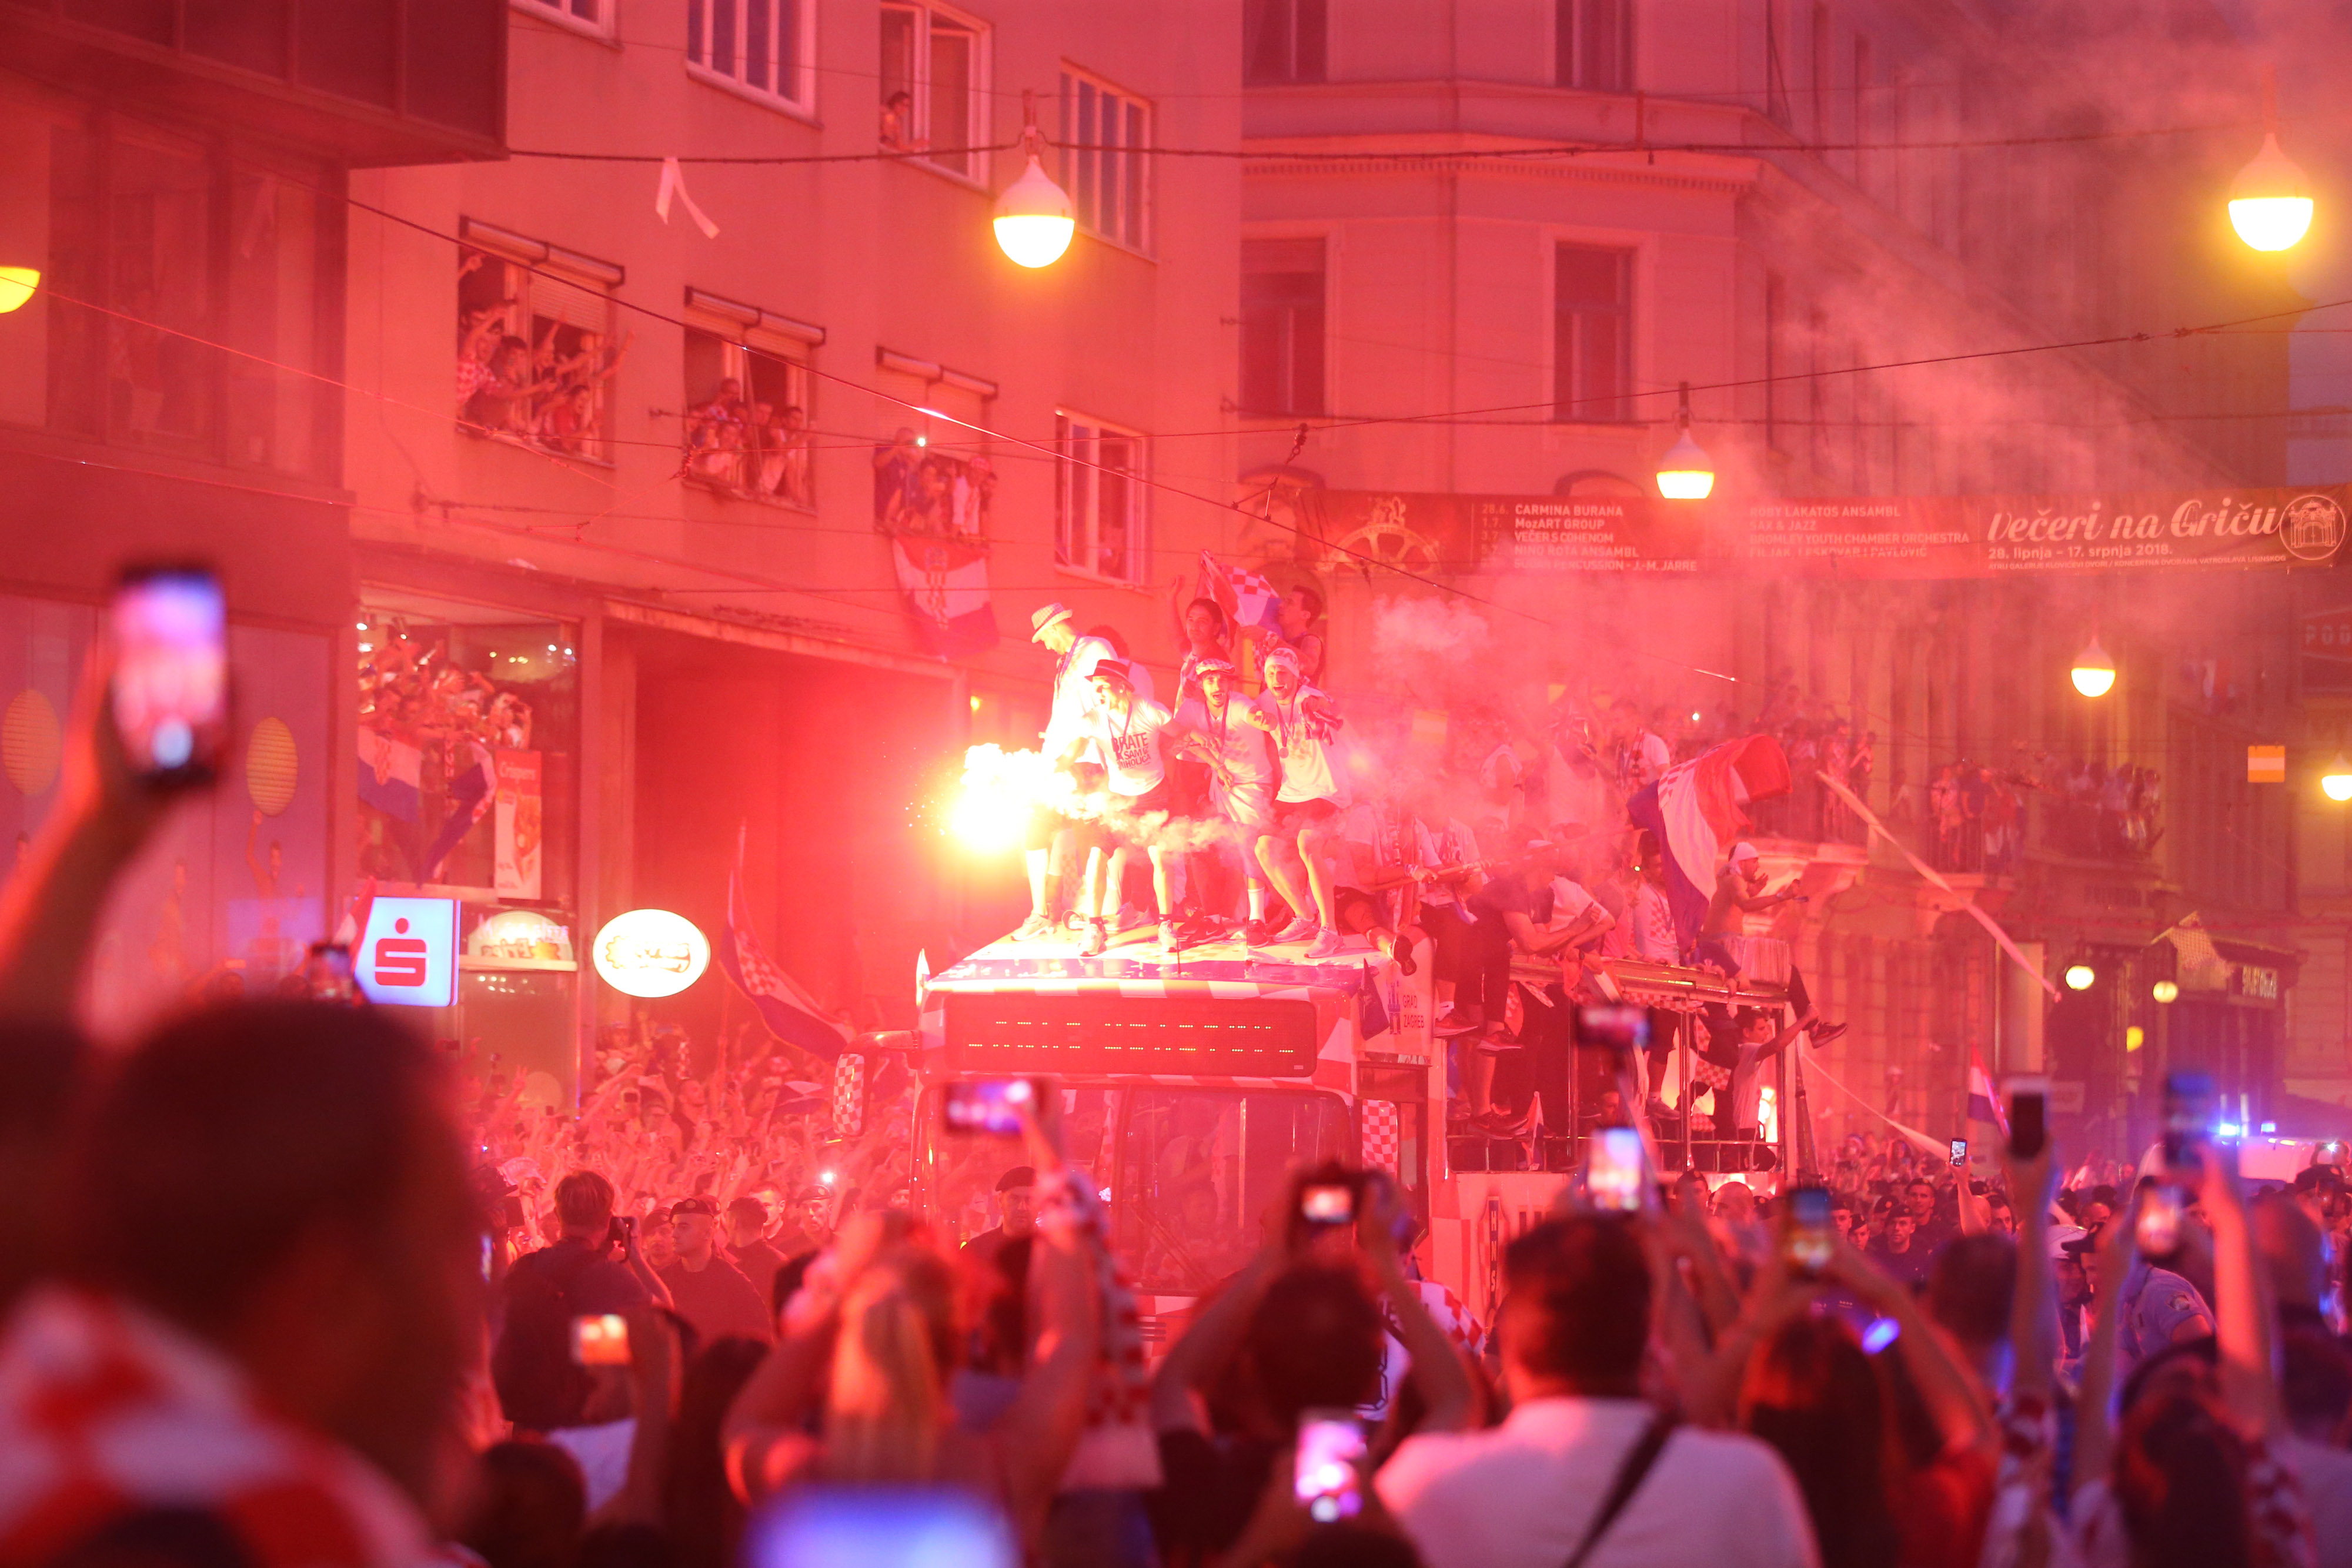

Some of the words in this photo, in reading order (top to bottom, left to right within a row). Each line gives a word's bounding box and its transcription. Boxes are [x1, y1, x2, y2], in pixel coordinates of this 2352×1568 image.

[1481, 504, 1508, 516] 28.6.
[1515, 504, 1569, 516] CARMINA
[1573, 505, 1623, 517] BURANA
[1750, 507, 1781, 517] ROBY
[1786, 506, 1839, 517] LAKATOS
[1842, 506, 1901, 517] ANSAMBL
[1482, 517, 1502, 529] 1.7.
[1515, 518, 1561, 529] MozART
[1564, 519, 1605, 530] GROUP
[1750, 520, 1771, 531] SAX
[1776, 520, 1784, 531] &
[1788, 520, 1816, 531] JAZZ
[1987, 501, 2103, 542] Večeri
[2109, 513, 2164, 540] na
[2170, 497, 2281, 538] Griču
[1515, 529, 1550, 542] VEČER
[1551, 532, 1558, 543] S
[1560, 531, 1613, 543] COHENOM
[1750, 533, 1802, 544] BROMLEY
[1805, 533, 1842, 544] YOUTH
[1845, 533, 1899, 544] CHAMBER
[1902, 532, 1969, 544] ORCHESTRA
[1515, 546, 1544, 556] NINO
[1547, 546, 1578, 556] ROTA
[1581, 547, 1639, 558] ANSAMBL
[1870, 546, 1927, 559] PAVLOVIĆ
[1987, 547, 2009, 560] 28.
[2013, 546, 2053, 562] lipnja
[2067, 546, 2085, 558] 17.
[2088, 544, 2132, 560] srpnja
[2135, 543, 2173, 556] 2018.
[1553, 560, 1624, 571] PERCUSSION
[1660, 561, 1698, 572] JARRE
[2161, 558, 2198, 566] DVORANA
[2199, 556, 2246, 565] VATROSLAVA
[2247, 555, 2286, 563] LISINSKOG
[1111, 732, 1148, 753] BRATE
[1124, 749, 1142, 760] SAM
[1403, 995, 1417, 1008] GRAD
[1404, 1015, 1424, 1029] ZAGREB
